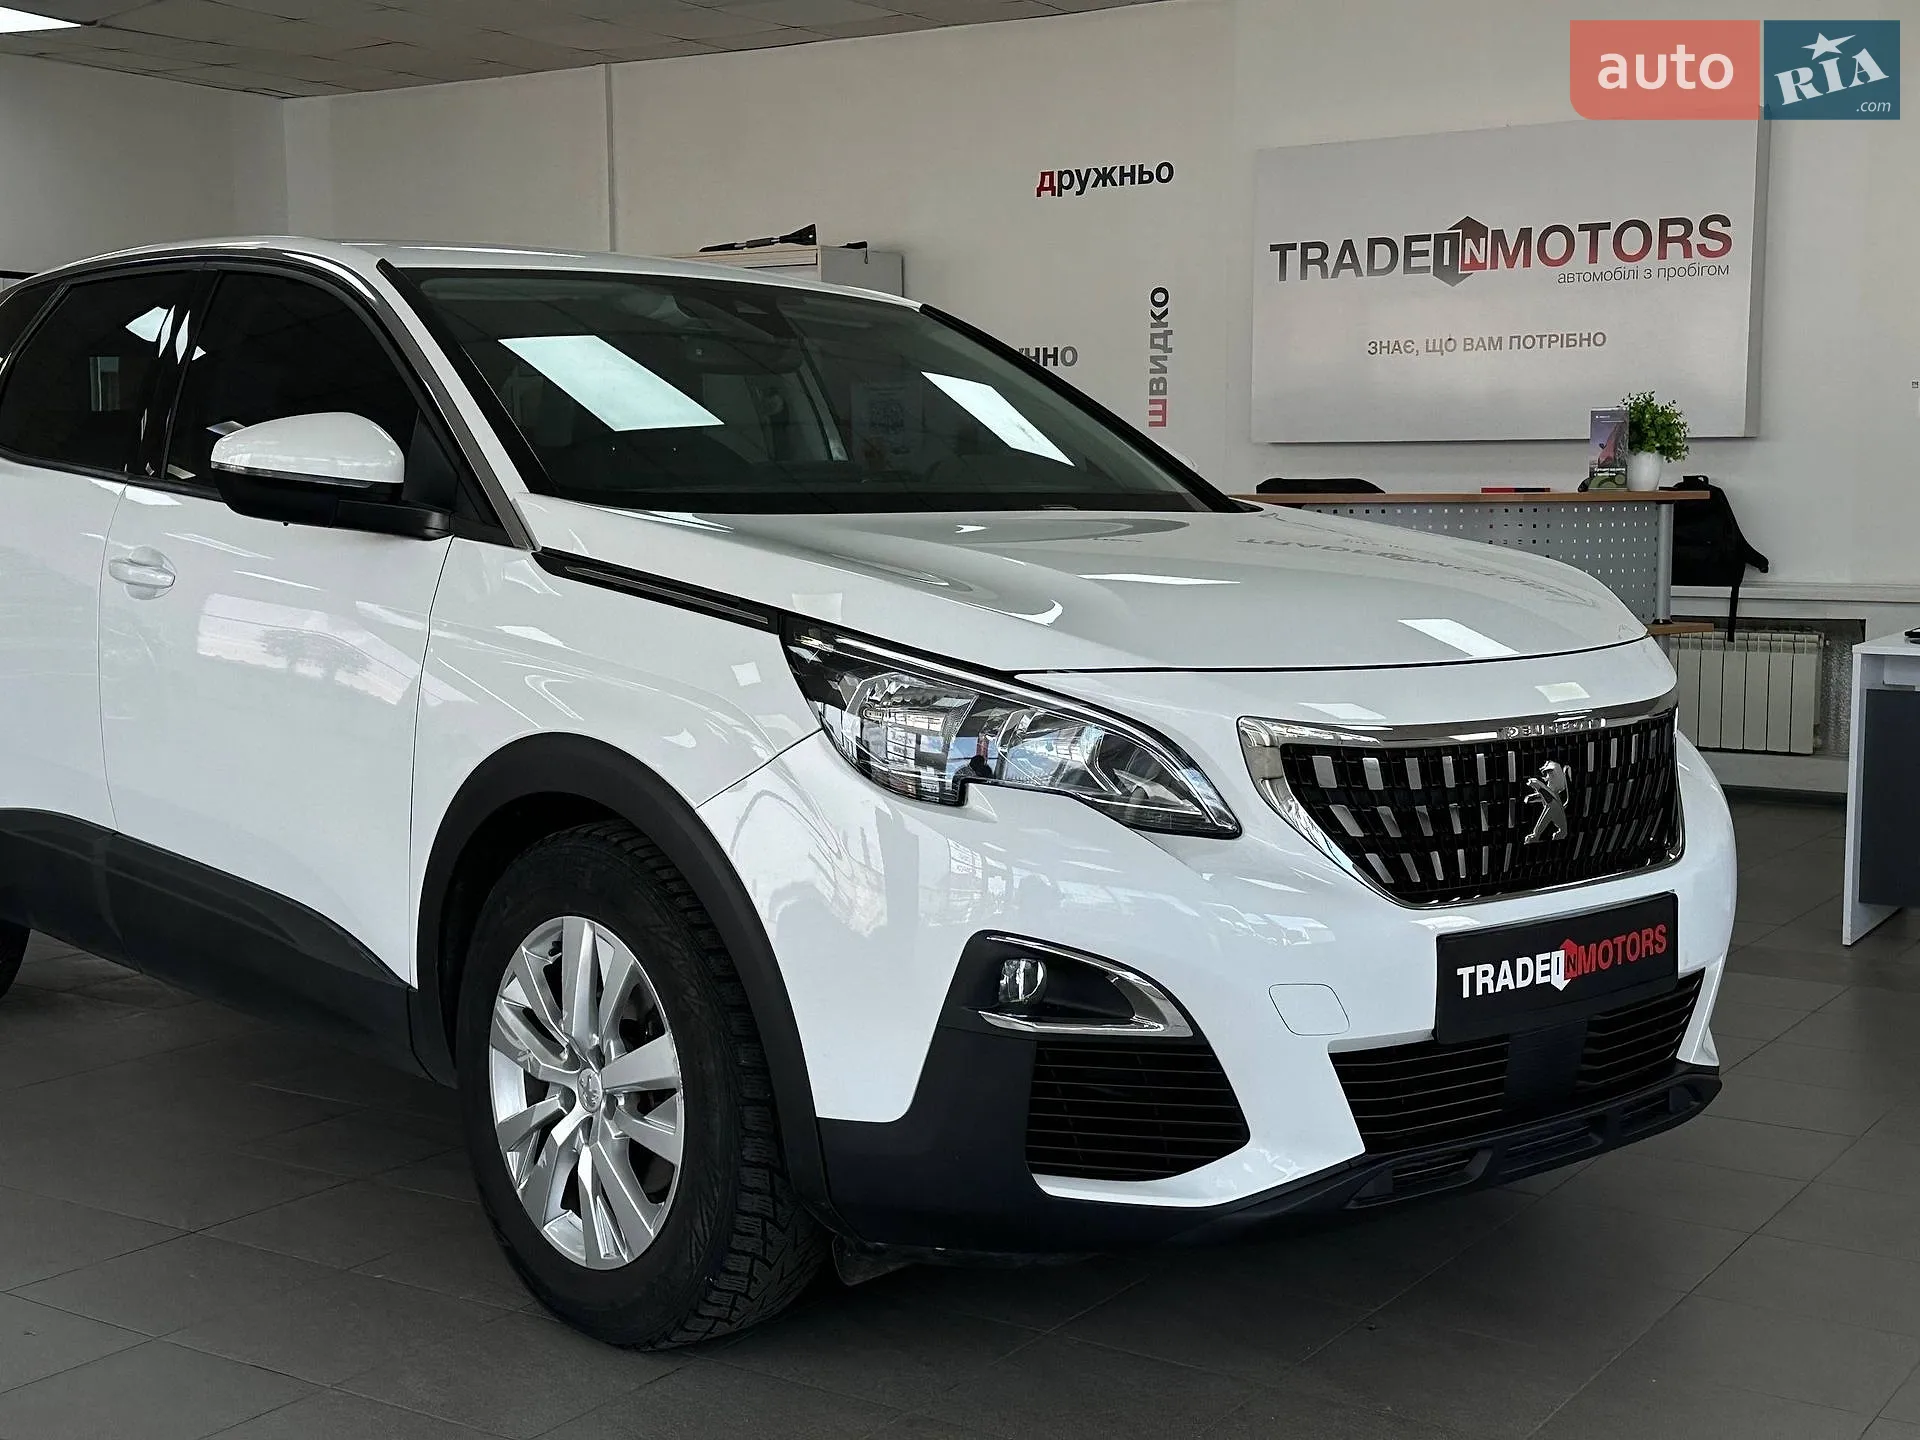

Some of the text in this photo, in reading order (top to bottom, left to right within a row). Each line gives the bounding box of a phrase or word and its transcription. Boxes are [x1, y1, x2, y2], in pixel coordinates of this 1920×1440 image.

[1036, 161, 1174, 198] дружньо
[1557, 262, 1730, 284] автомобілі з пробігом
[1367, 331, 1607, 356] ЗНАЄ, ЩО ВАМ ПОТРІБНО
